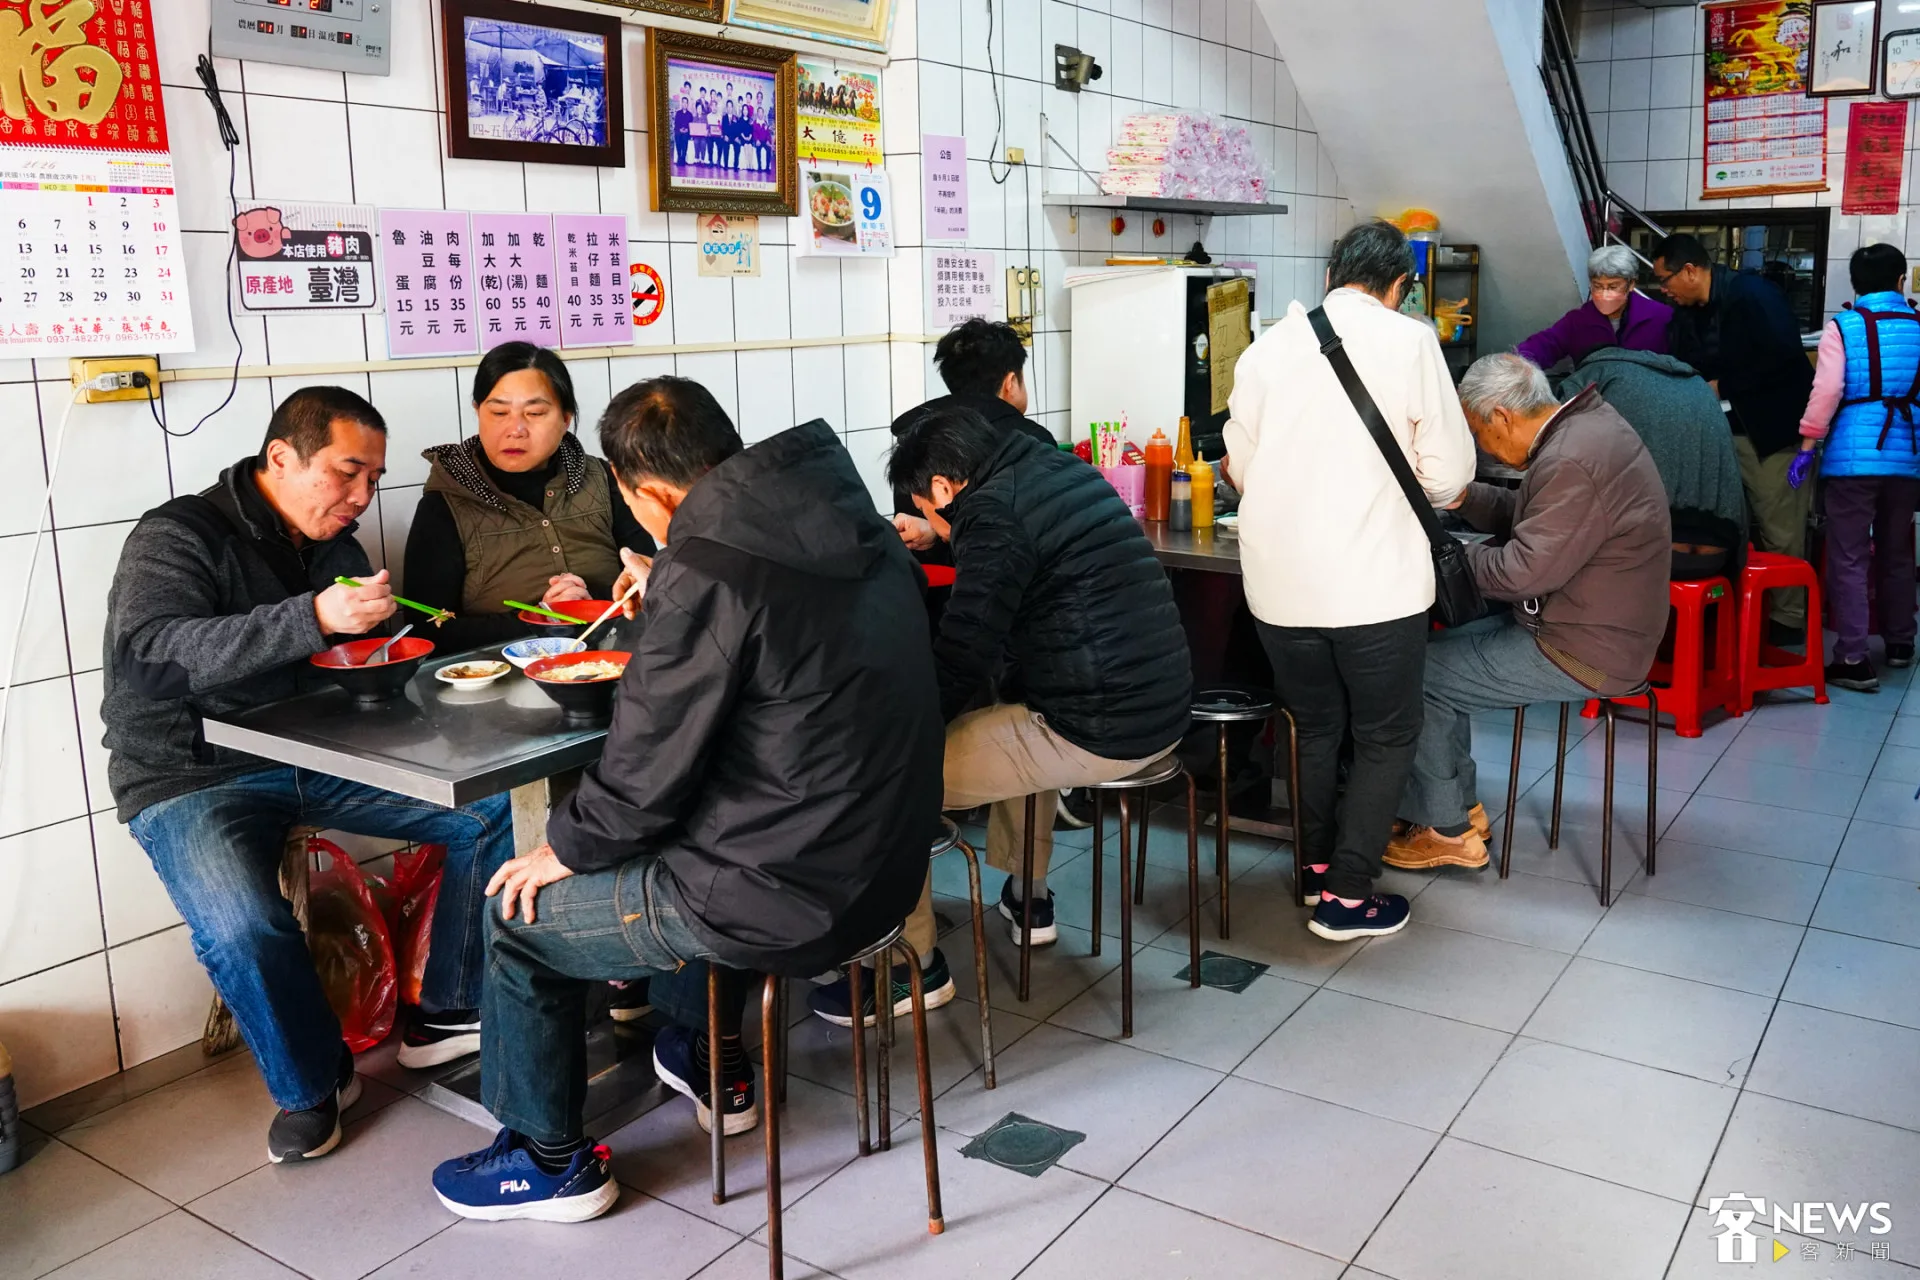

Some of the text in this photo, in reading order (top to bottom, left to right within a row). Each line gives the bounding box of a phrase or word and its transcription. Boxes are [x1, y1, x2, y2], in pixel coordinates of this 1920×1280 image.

[276, 24, 283, 34] 月
[308, 29, 314, 38] 日
[1892, 47, 1902, 55] 10
[940, 150, 952, 160] 公告
[88, 196, 159, 208] 1 2 3
[860, 186, 882, 220] 9
[18, 219, 165, 232] 6 7 8 9 10
[19, 244, 168, 255] 13 14 15 16 17
[21, 268, 171, 278] 20 21 22 23 24
[246, 266, 360, 302] 原產地 臺灣
[24, 291, 173, 303] 27 28 29 30 31
[500, 1179, 530, 1194] FILA
